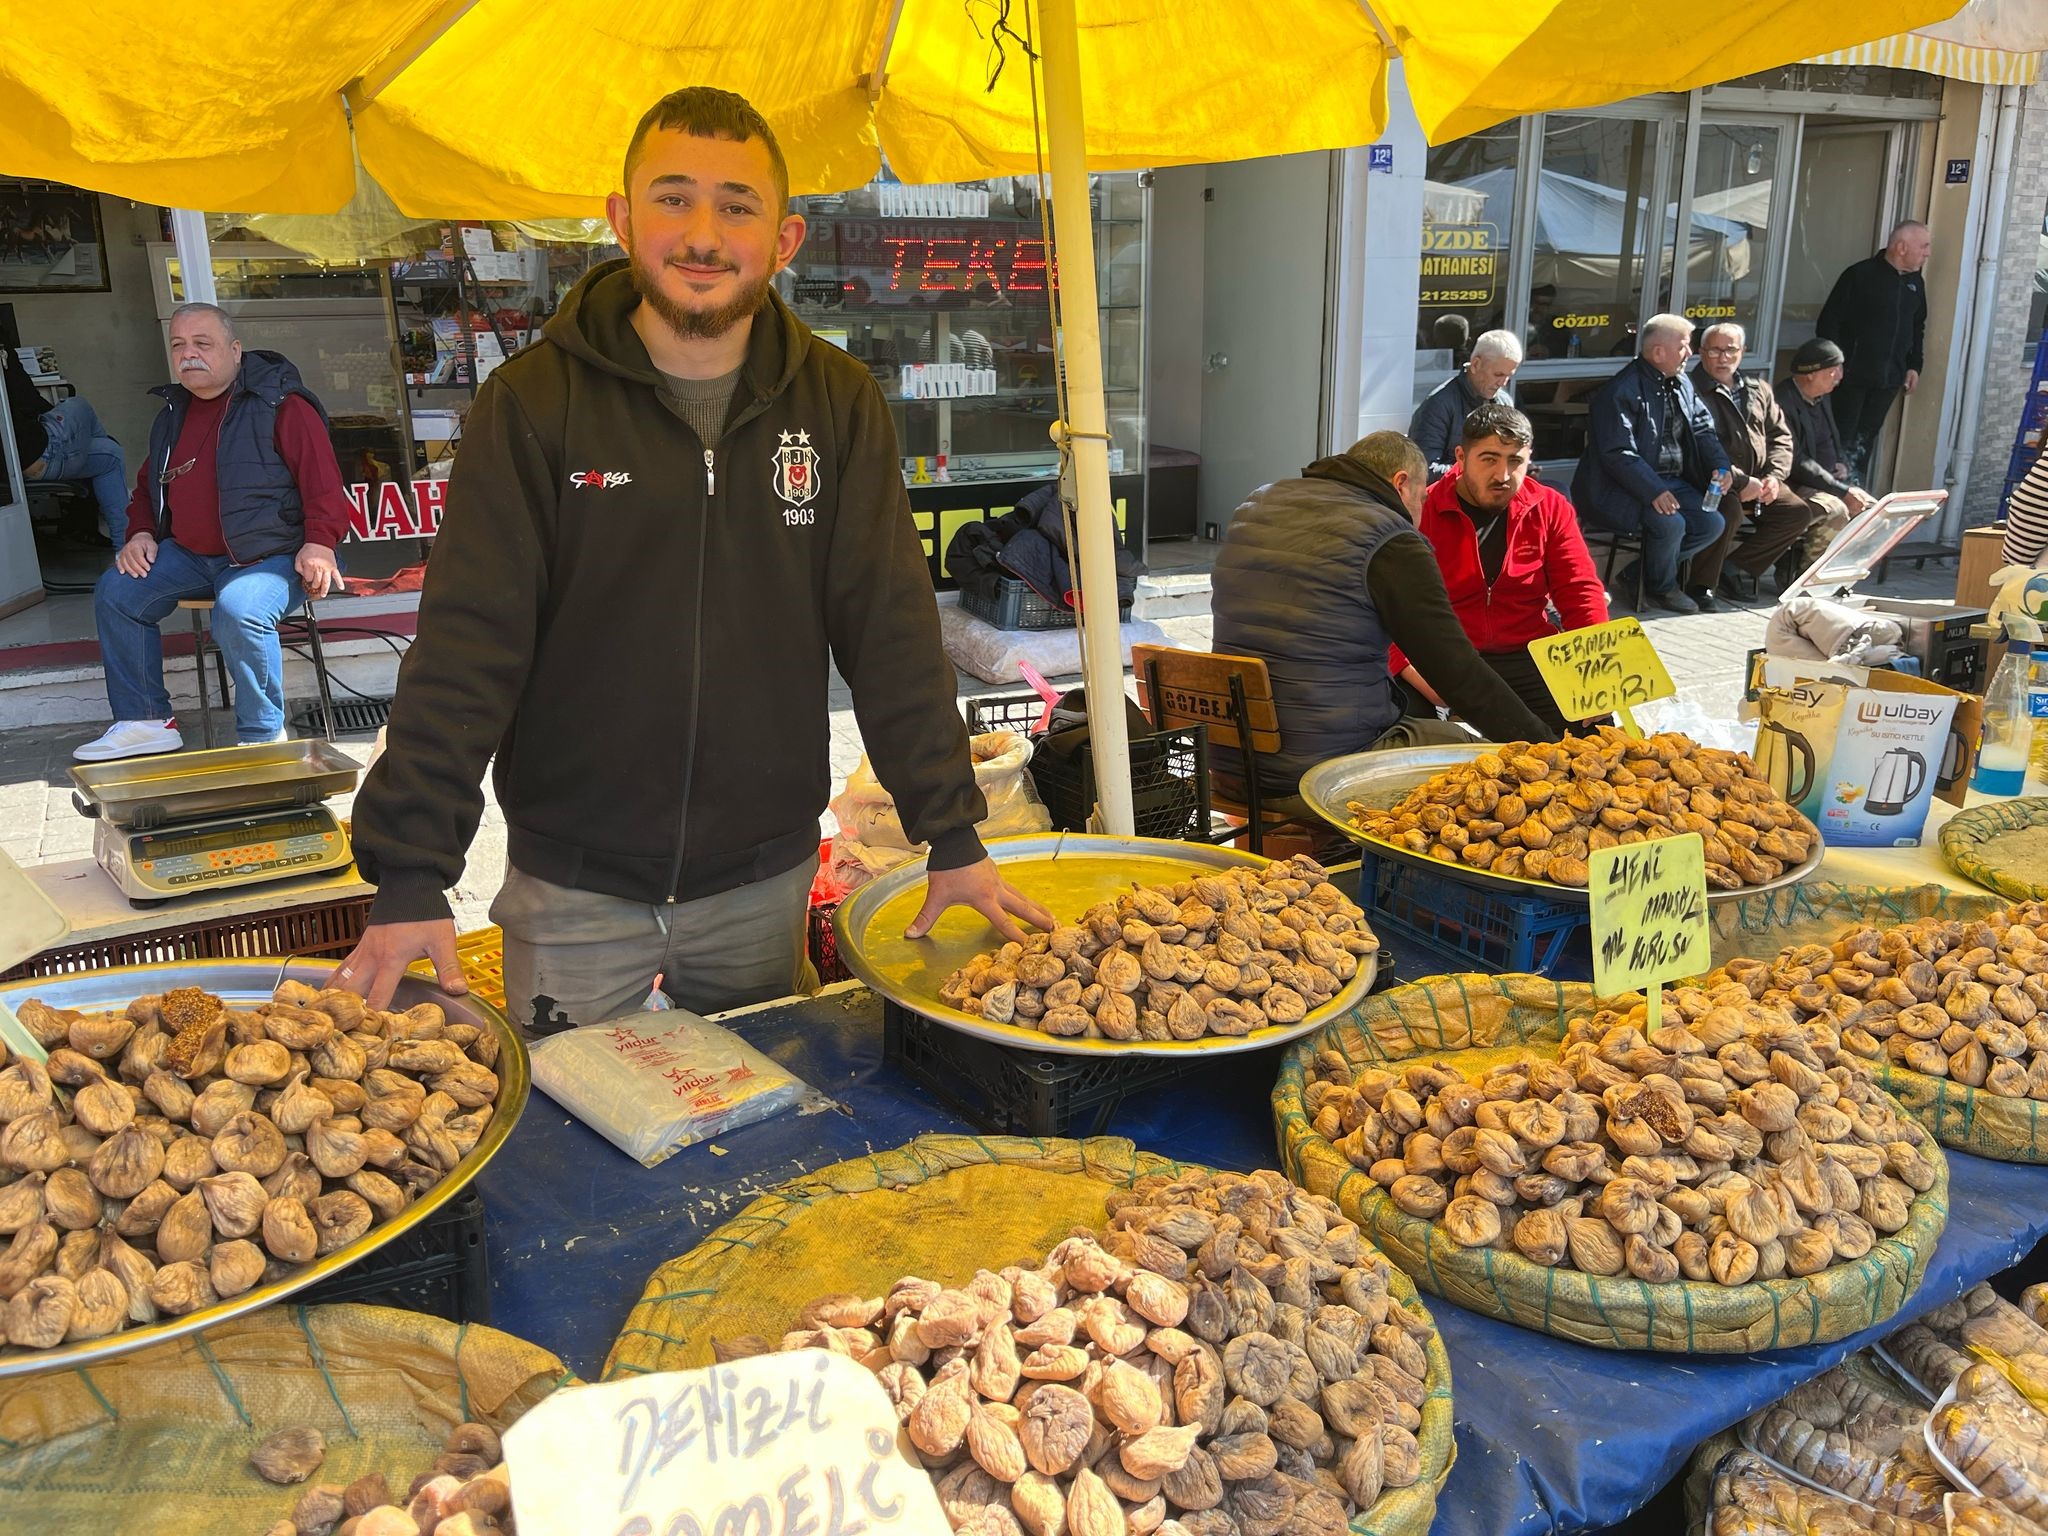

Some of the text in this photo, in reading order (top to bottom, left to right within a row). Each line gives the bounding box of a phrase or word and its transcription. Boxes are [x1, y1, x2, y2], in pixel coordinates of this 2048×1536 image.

[883, 238, 1059, 291] TEKE
[1684, 304, 1737, 319] GÖZDE
[1552, 313, 1610, 329] GÖZDE
[783, 450, 812, 464] BJK
[786, 488, 810, 498] 1903
[782, 508, 815, 526] 1903
[1884, 703, 1943, 726] ulbay
